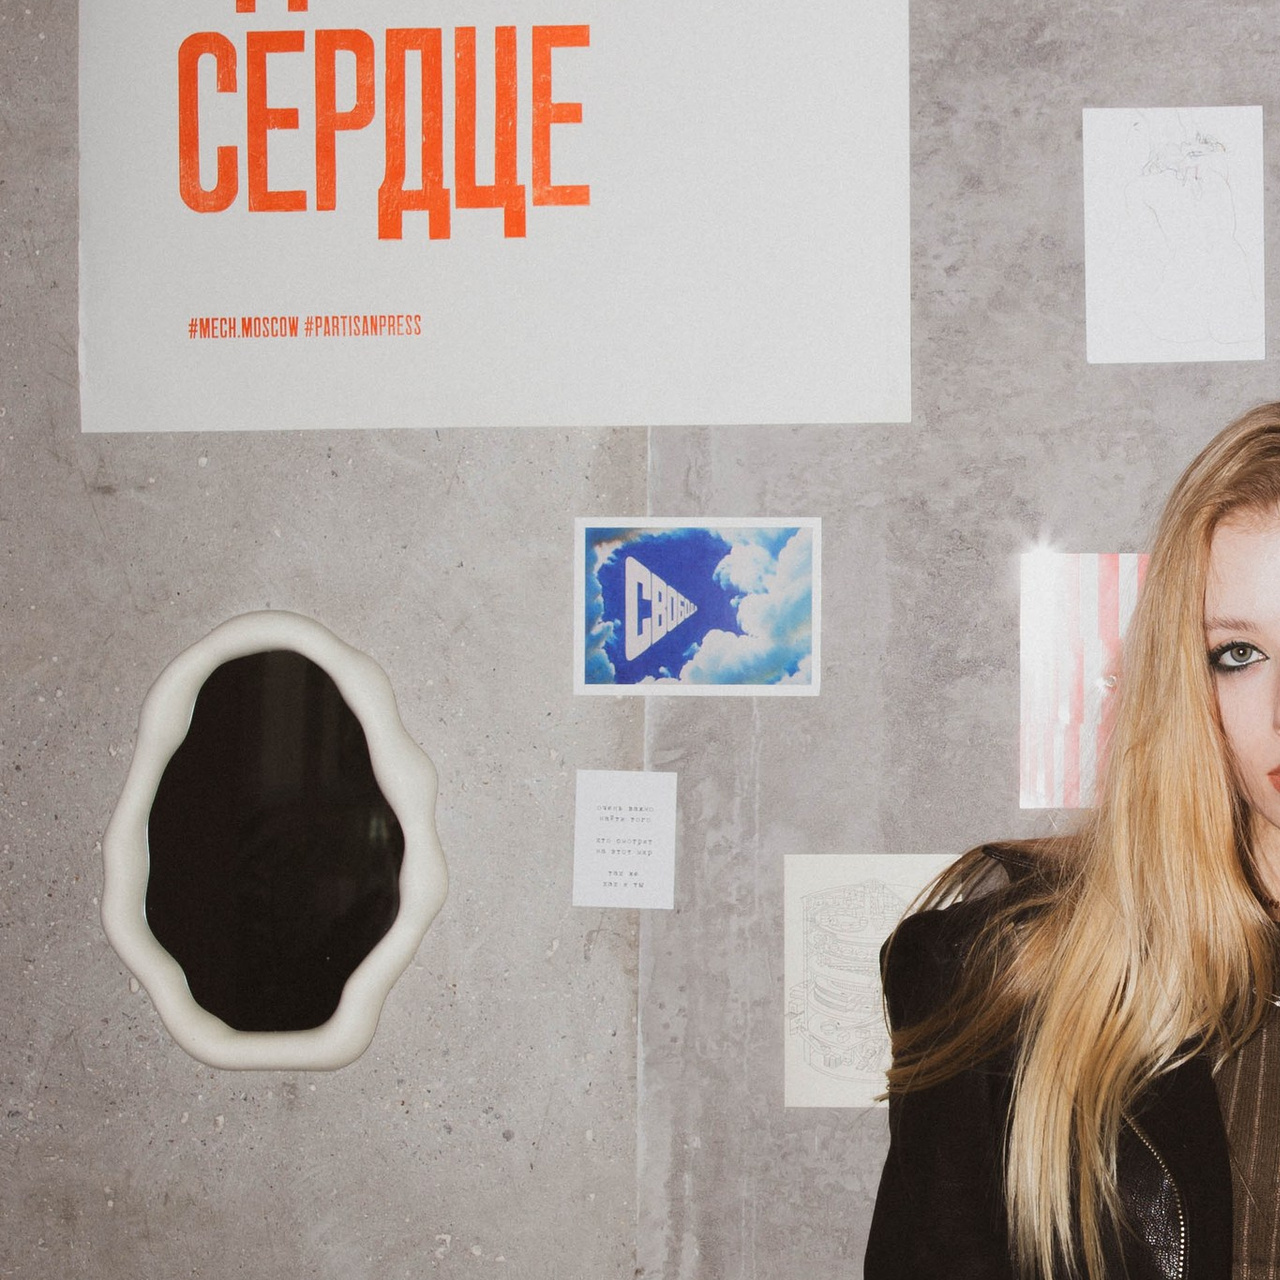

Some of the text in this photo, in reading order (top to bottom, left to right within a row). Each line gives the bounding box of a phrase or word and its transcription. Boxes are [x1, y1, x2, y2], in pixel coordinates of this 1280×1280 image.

[177, 24, 591, 241] СЕРДЦЕ
[188, 315, 422, 339] #MECH.MOSCOW #PARTISANPRESS
